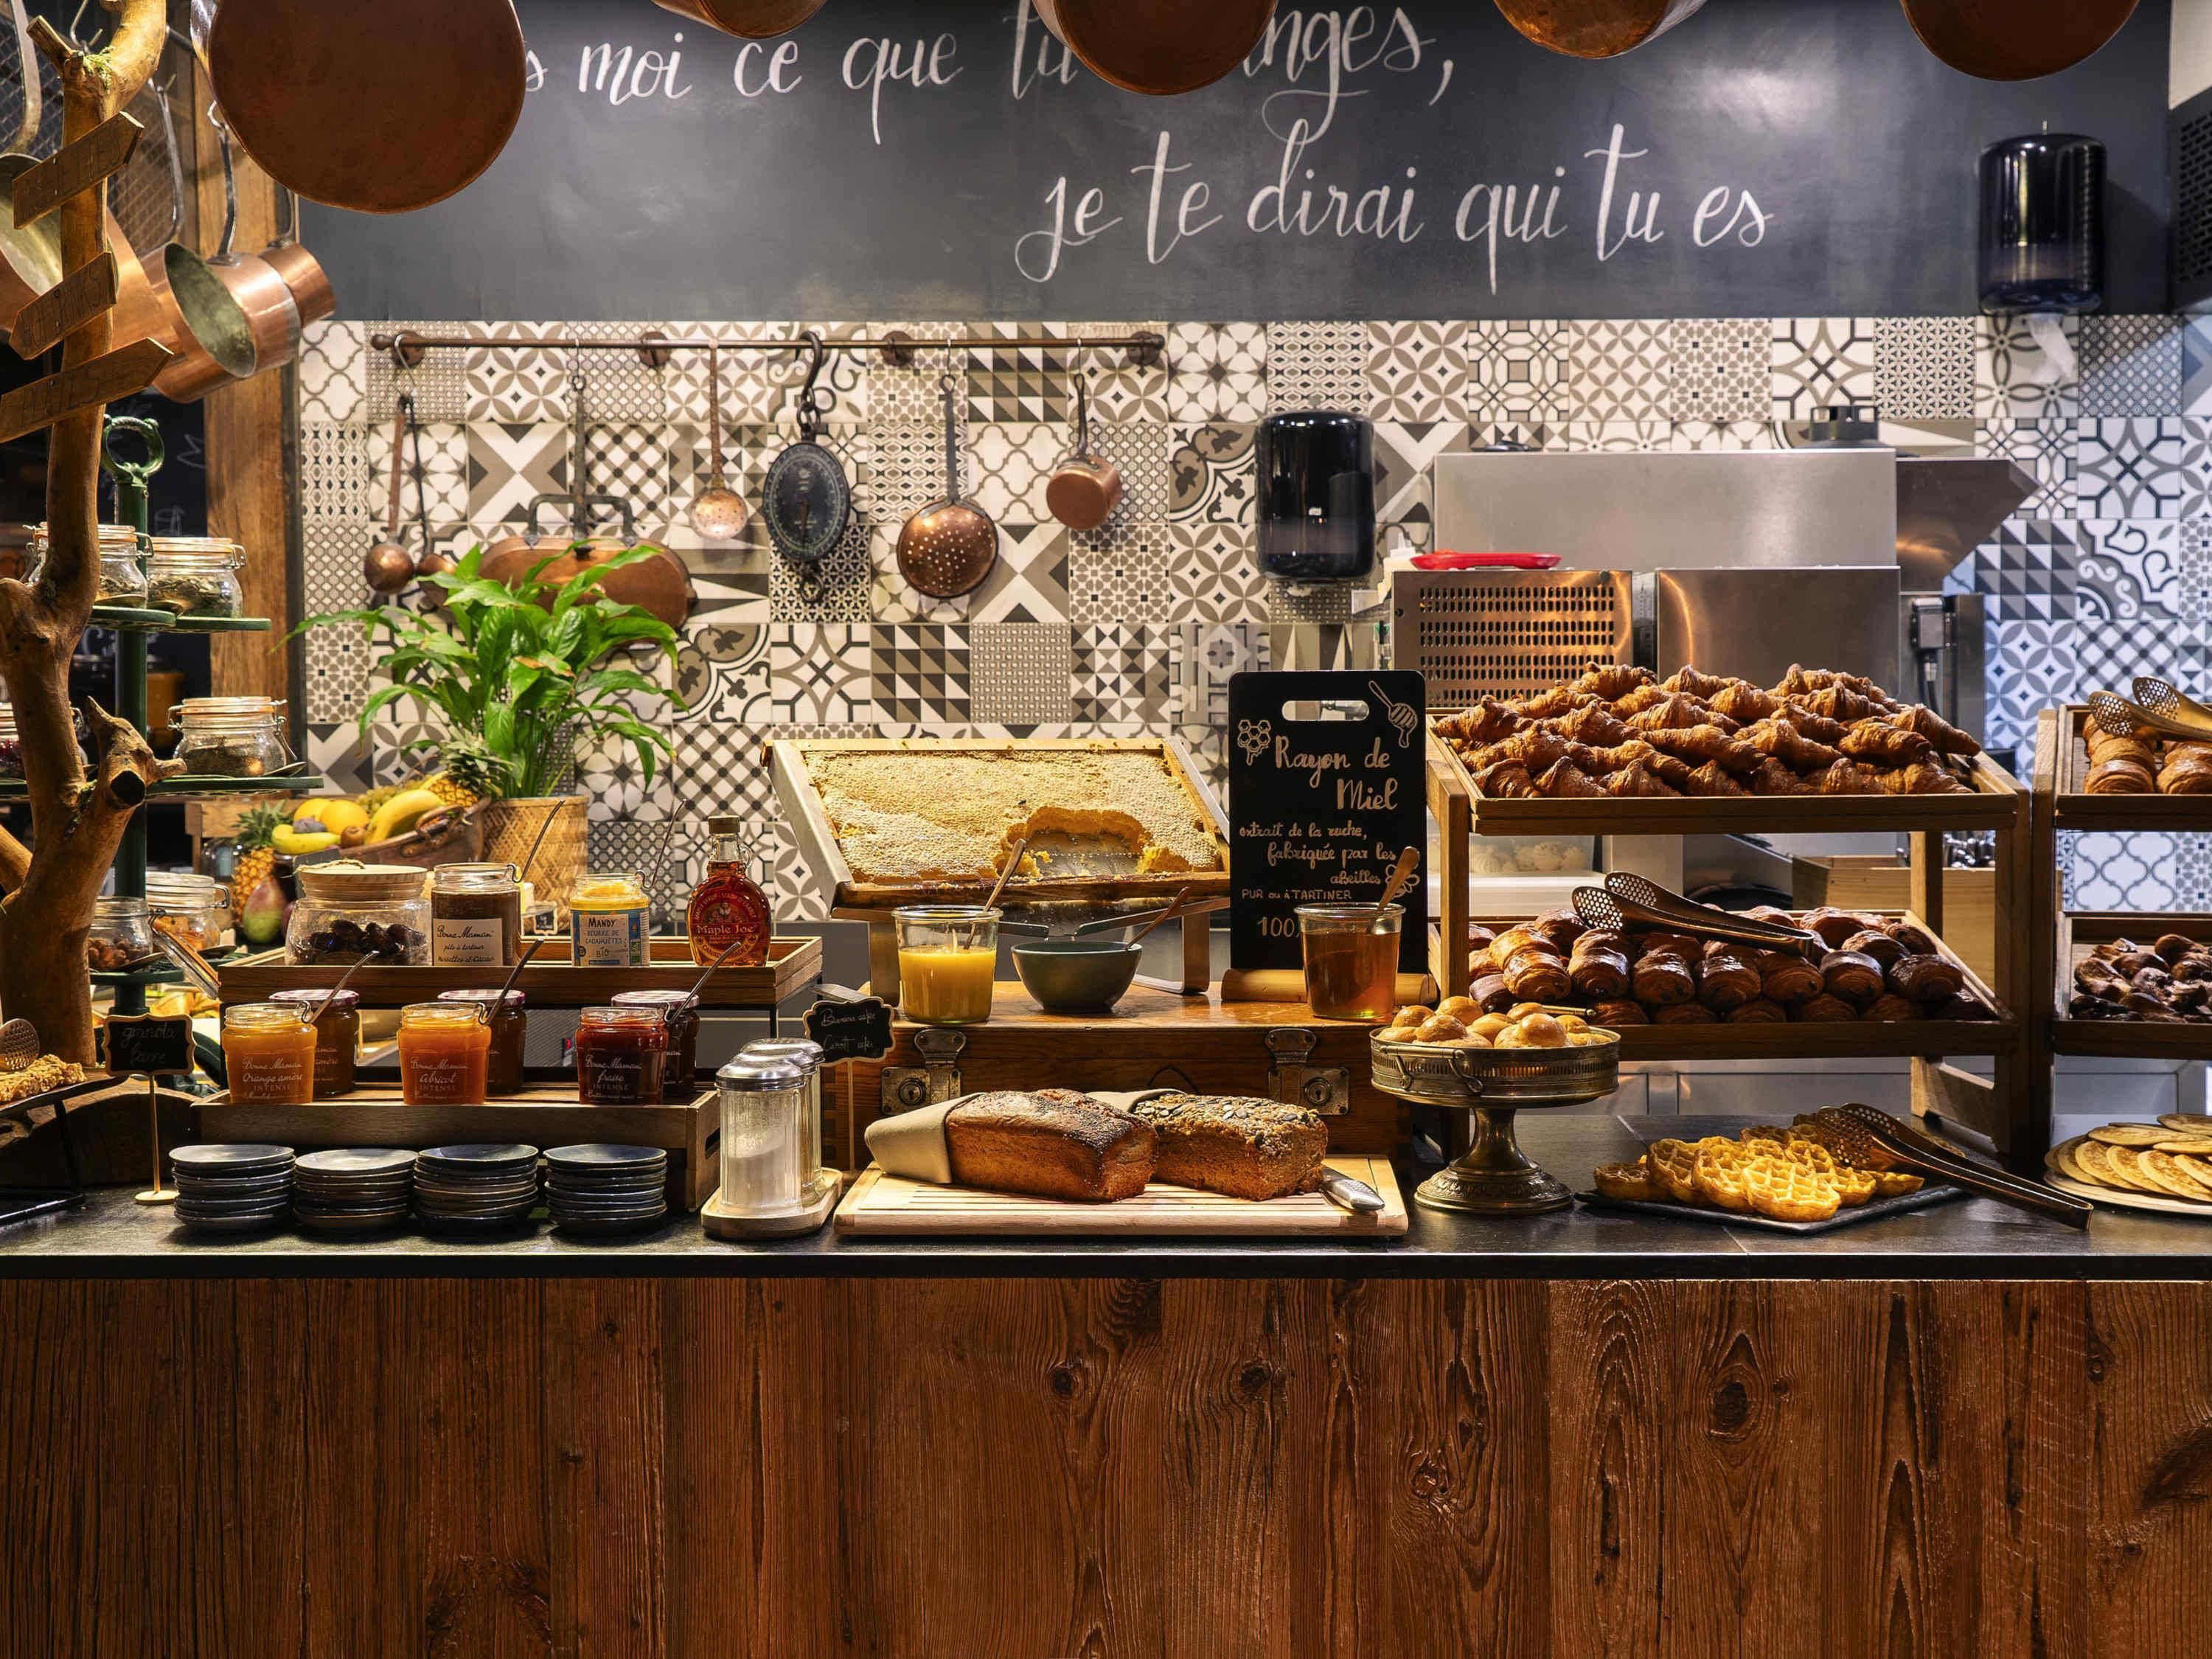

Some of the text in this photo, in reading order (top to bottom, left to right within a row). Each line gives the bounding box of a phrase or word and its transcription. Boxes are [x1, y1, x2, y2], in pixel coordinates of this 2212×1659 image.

[578, 32, 693, 105] moi
[733, 40, 802, 97] ce
[842, 32, 963, 145] que
[1003, 0, 1079, 100] tu
[1243, 6, 1454, 145] nges,
[1015, 118, 1775, 295] je te dirai qui tu es
[1275, 736, 1391, 788] Rayon de
[1337, 778, 1398, 810] Miel
[1239, 820, 1368, 840] extrait de la ruche,
[1267, 841, 1397, 870] fabriquée par les
[1330, 869, 1381, 885] abeilles
[1242, 889, 1263, 899] PUR
[1284, 889, 1290, 899] à
[1291, 889, 1352, 900] TARTINER
[437, 925, 493, 938] Bonne Maman
[696, 925, 755, 936] Maple Joe
[1257, 917, 1301, 938] 100
[243, 1073, 276, 1085] Orange
